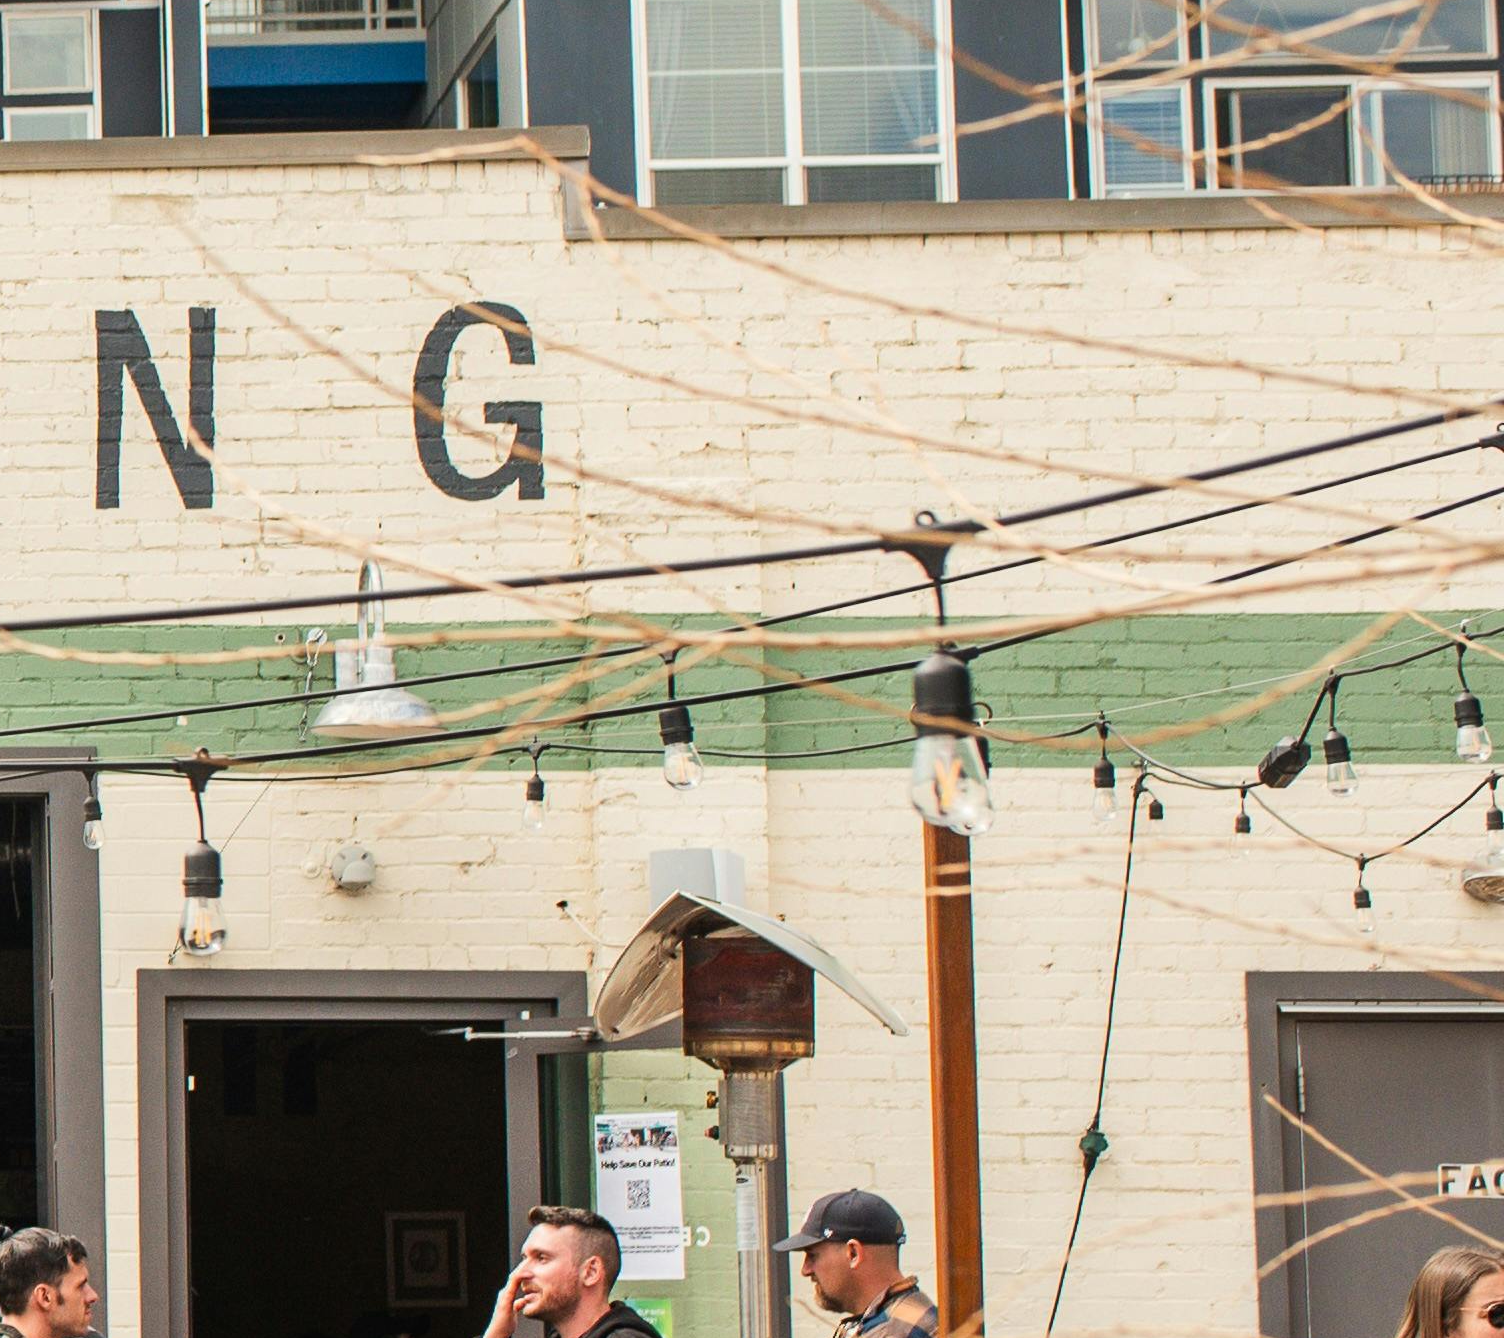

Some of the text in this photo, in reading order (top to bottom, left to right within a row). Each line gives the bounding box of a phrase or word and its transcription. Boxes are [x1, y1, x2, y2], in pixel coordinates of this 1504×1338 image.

[601, 1160, 618, 1170] Help
[619, 1160, 637, 1168] Save
[638, 1160, 652, 1168] Our
